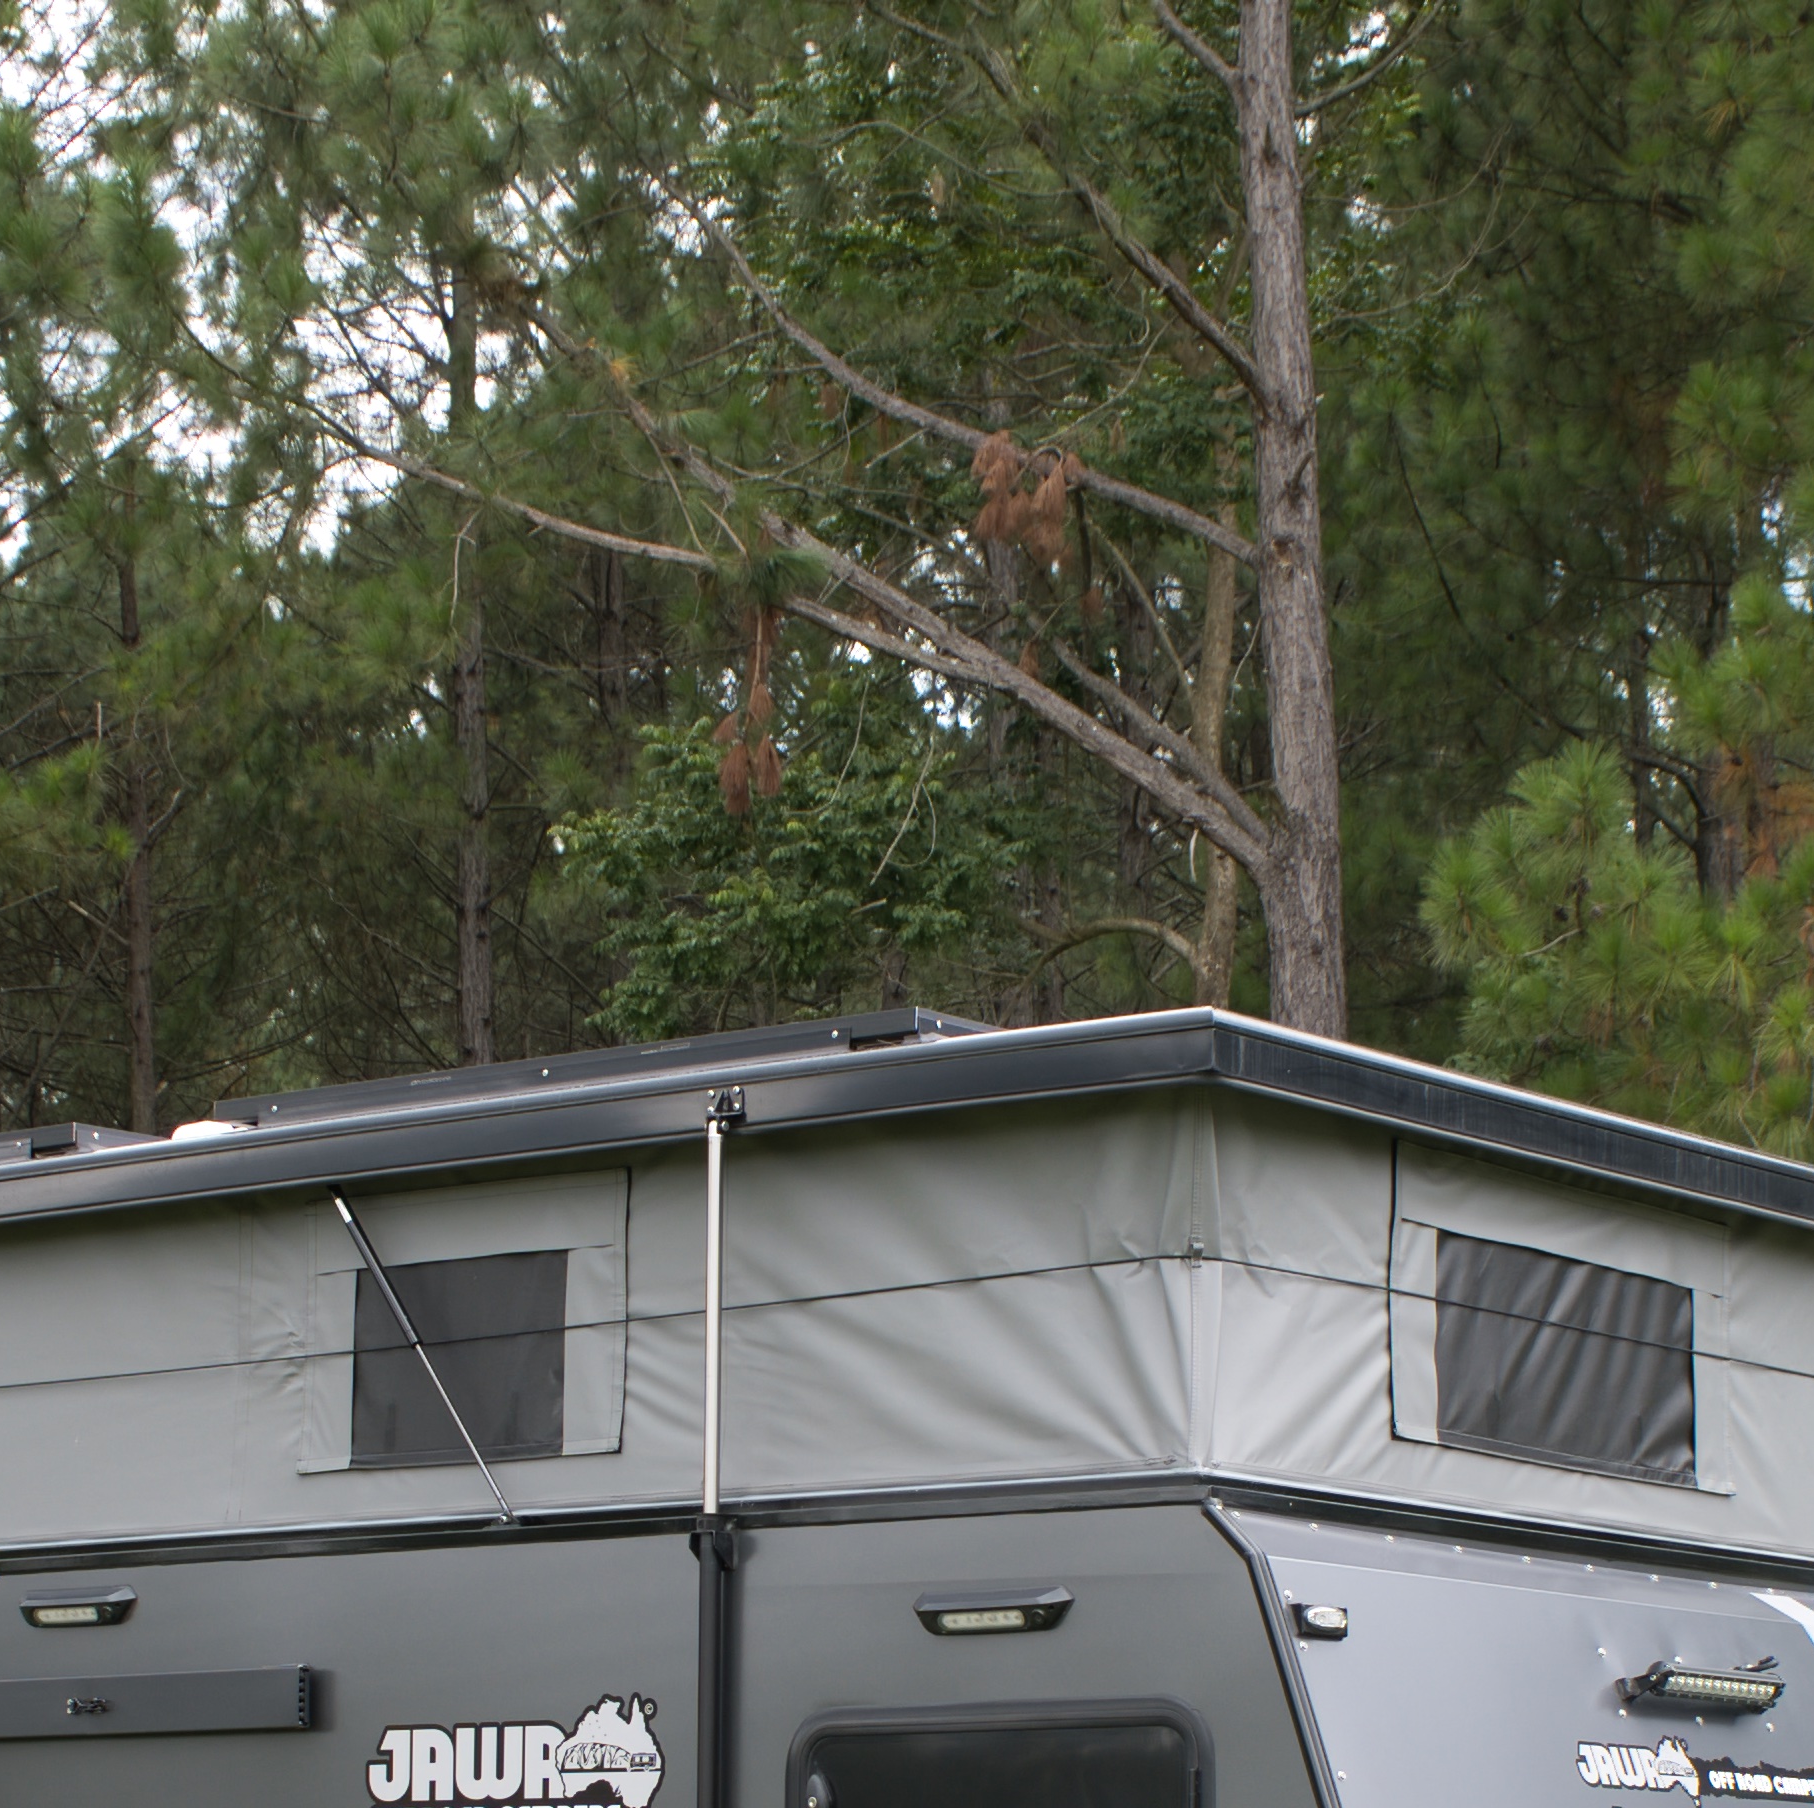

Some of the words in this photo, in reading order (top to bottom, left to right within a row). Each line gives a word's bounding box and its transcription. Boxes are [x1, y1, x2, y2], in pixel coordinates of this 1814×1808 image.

[367, 1724, 568, 1802] JAWA
[1576, 1742, 1667, 1790] JAWA
[1708, 1769, 1736, 1790] OFF
[1735, 1772, 1773, 1793] ROAD
